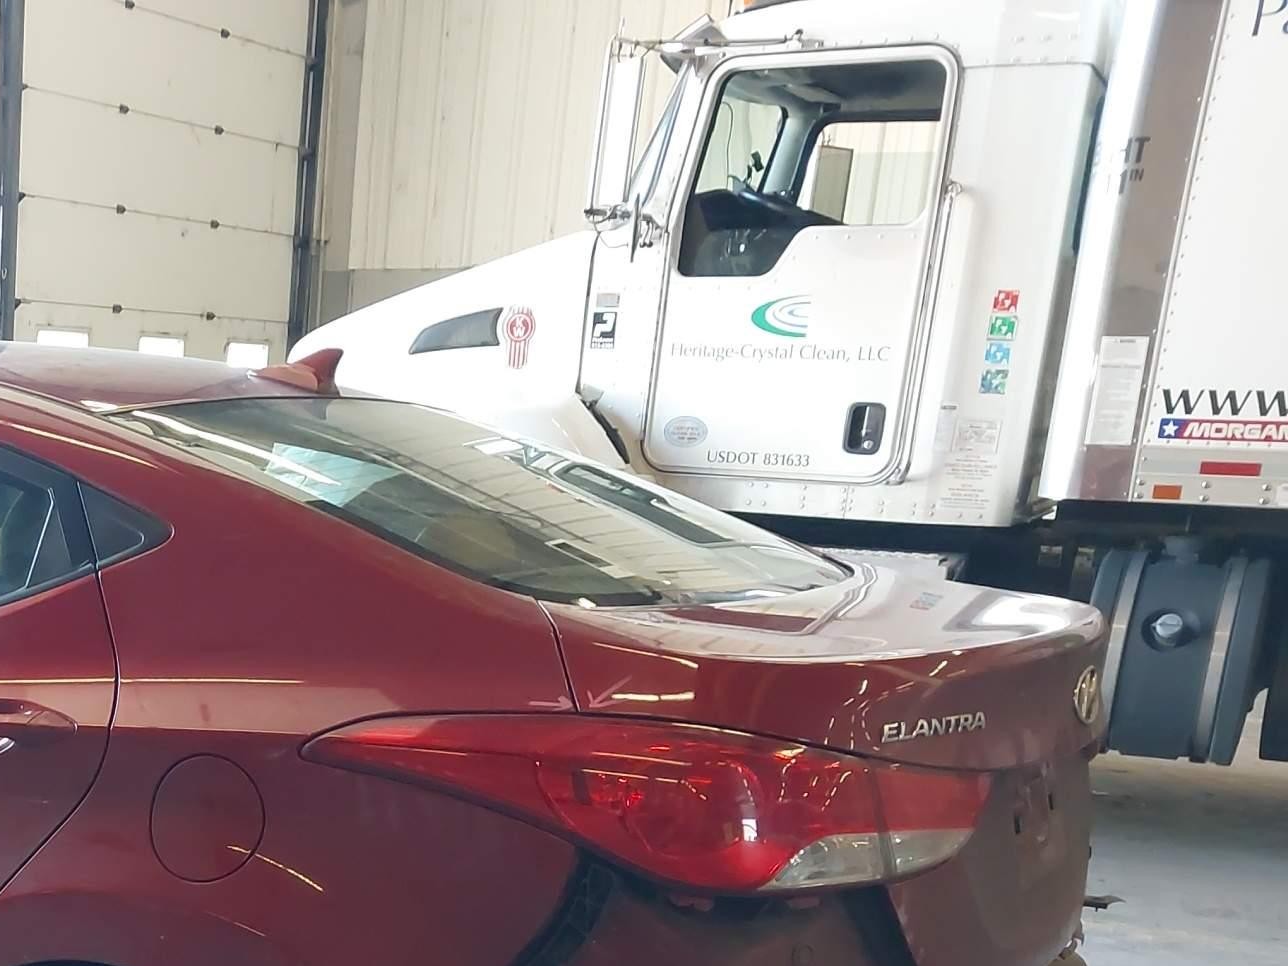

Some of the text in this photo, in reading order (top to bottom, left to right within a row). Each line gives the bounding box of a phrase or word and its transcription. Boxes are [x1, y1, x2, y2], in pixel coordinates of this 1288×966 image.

[670, 343, 891, 363] Heritage-Crystal Clean, LLC
[707, 450, 810, 467] USDOT 831633
[881, 711, 987, 743] ELANTRA
